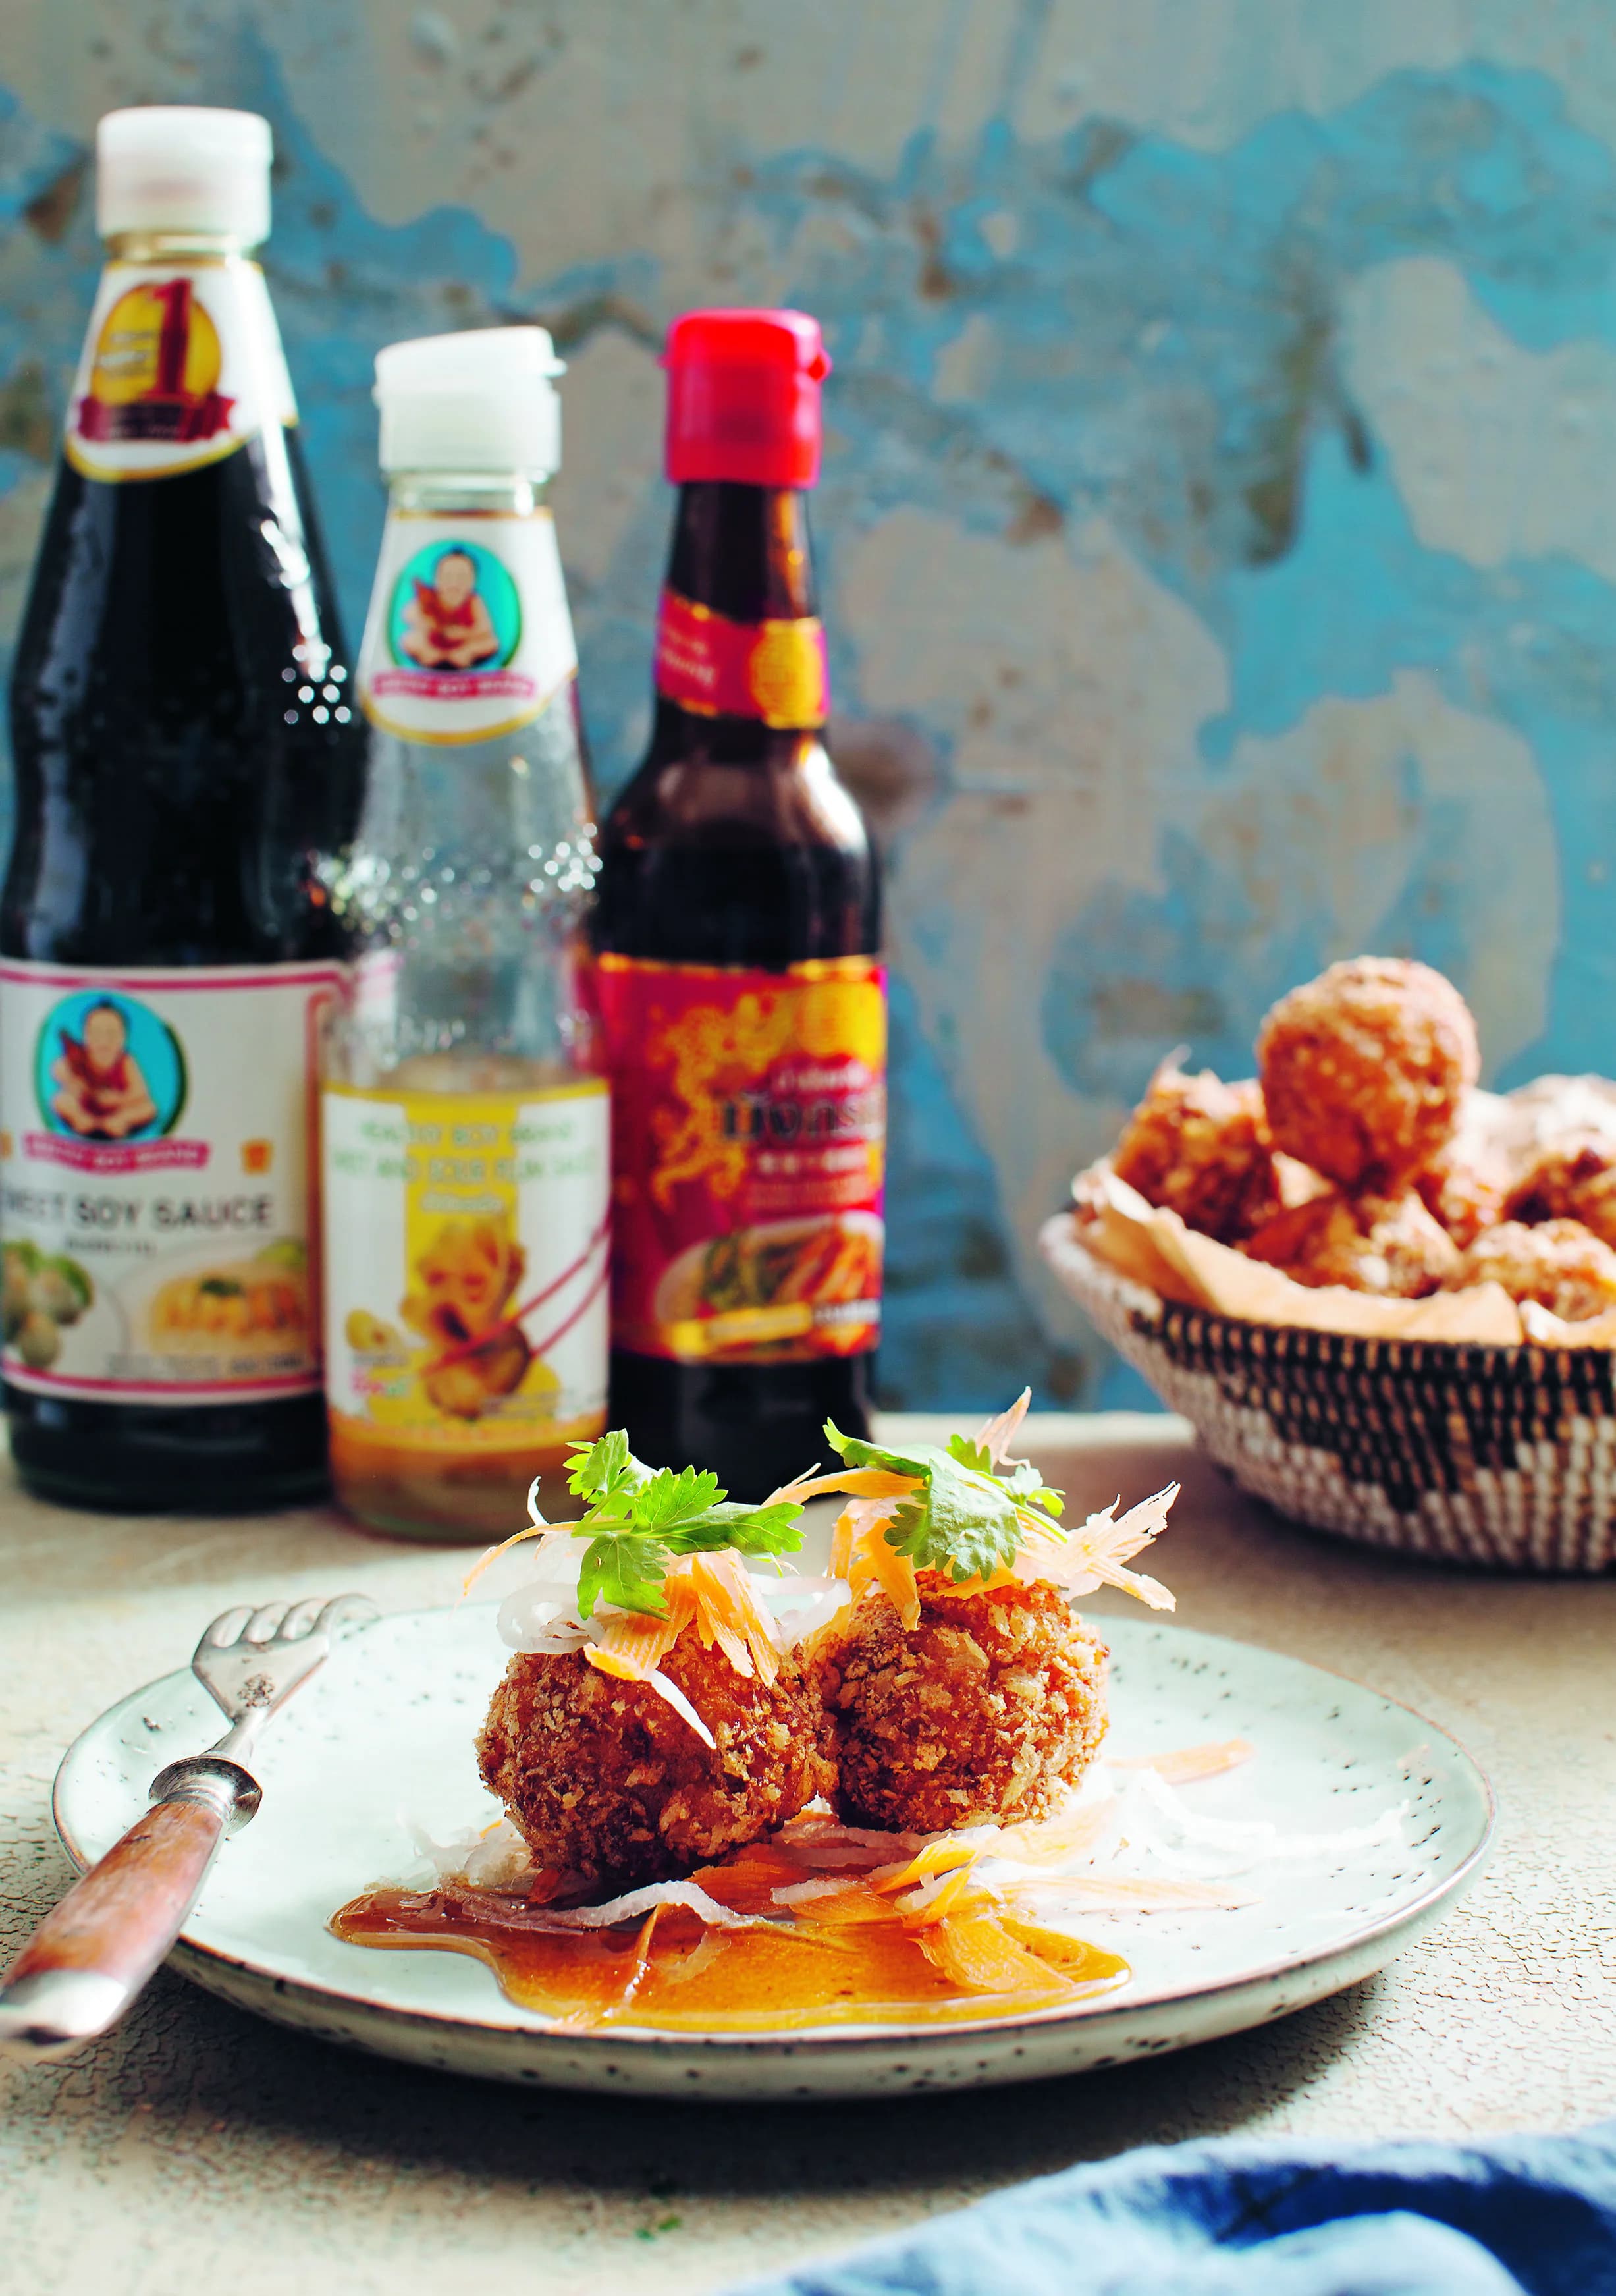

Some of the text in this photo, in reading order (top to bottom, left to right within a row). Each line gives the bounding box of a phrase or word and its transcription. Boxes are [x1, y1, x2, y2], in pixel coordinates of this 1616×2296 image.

[141, 277, 207, 403] 1
[74, 1193, 142, 1228] SOY
[152, 1193, 274, 1229] SAUCE
